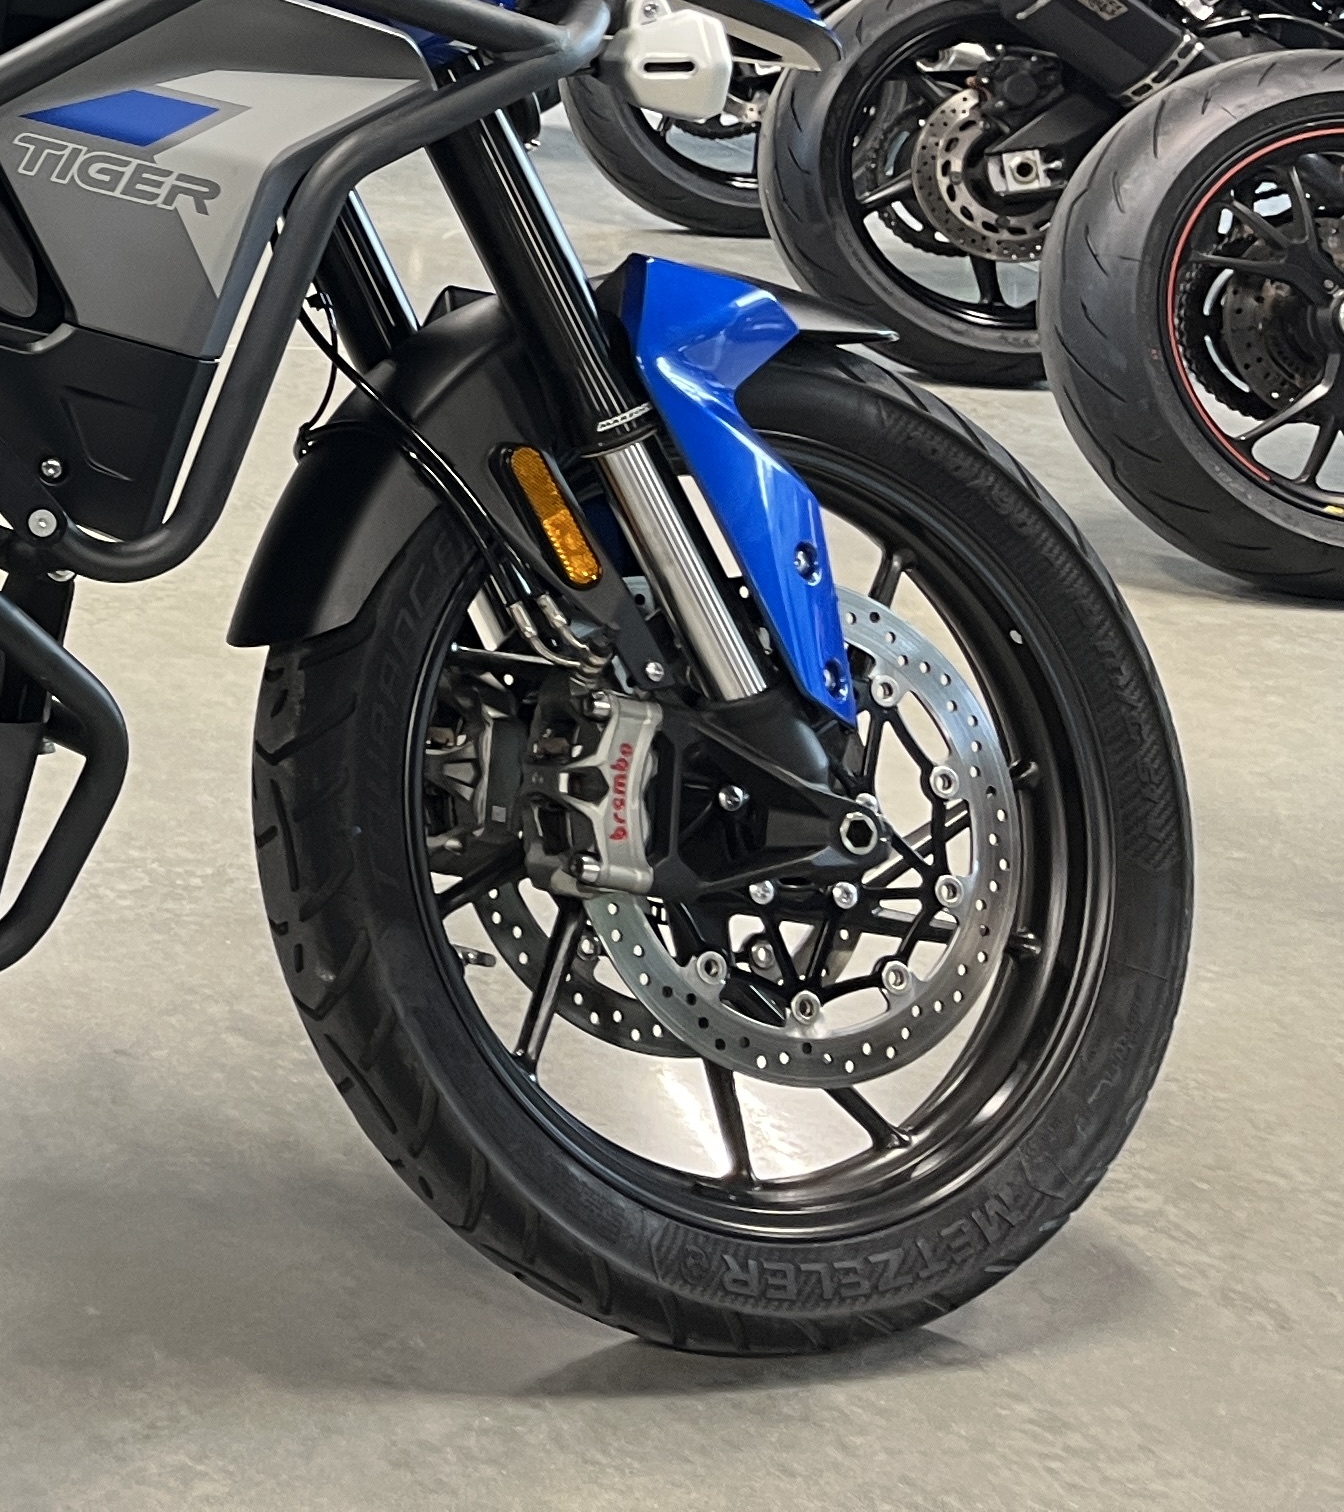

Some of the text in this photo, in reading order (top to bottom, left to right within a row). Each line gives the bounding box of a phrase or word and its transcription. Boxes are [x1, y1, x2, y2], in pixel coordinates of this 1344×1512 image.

[13, 133, 221, 216] TIGER
[609, 742, 633, 840] brembo
[721, 1190, 1014, 1300] METZELER
